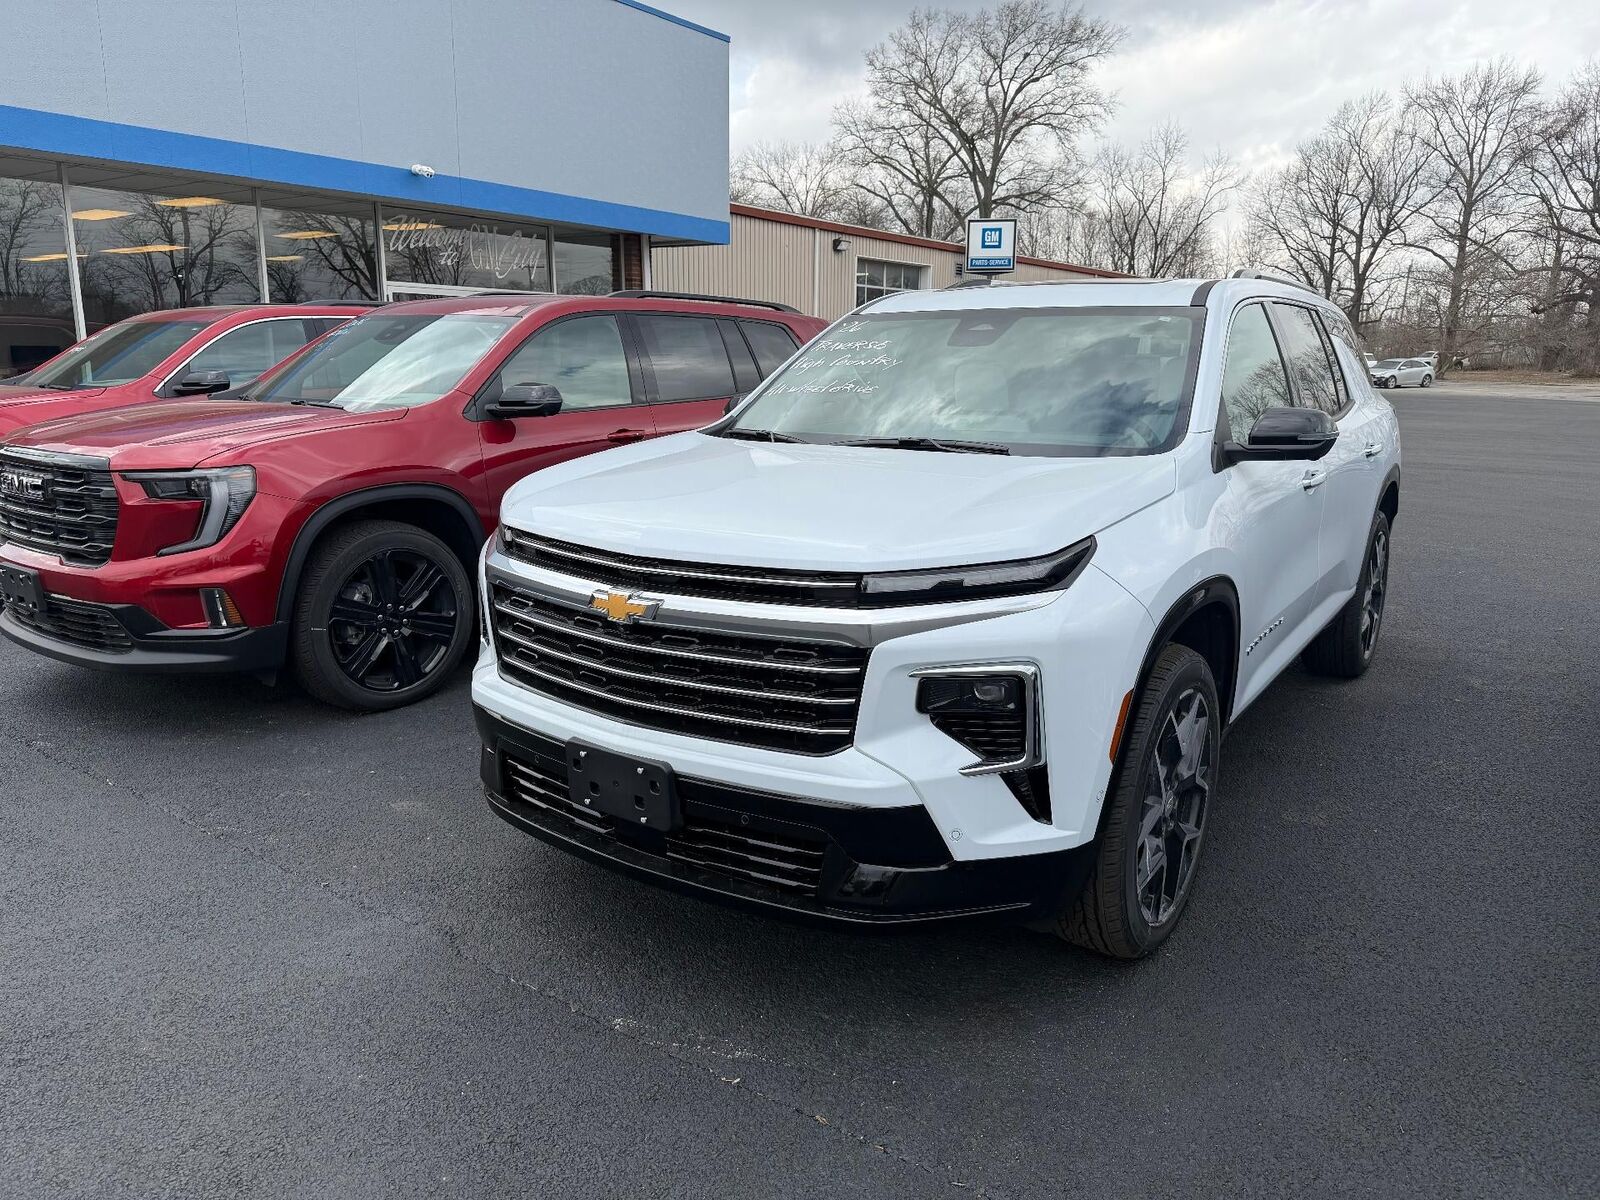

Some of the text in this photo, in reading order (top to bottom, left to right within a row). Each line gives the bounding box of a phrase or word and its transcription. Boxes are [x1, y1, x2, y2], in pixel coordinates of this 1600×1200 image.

[388, 215, 467, 251] Welcome
[985, 231, 999, 242] GM
[439, 245, 459, 265] to
[0, 472, 44, 499] GMC
